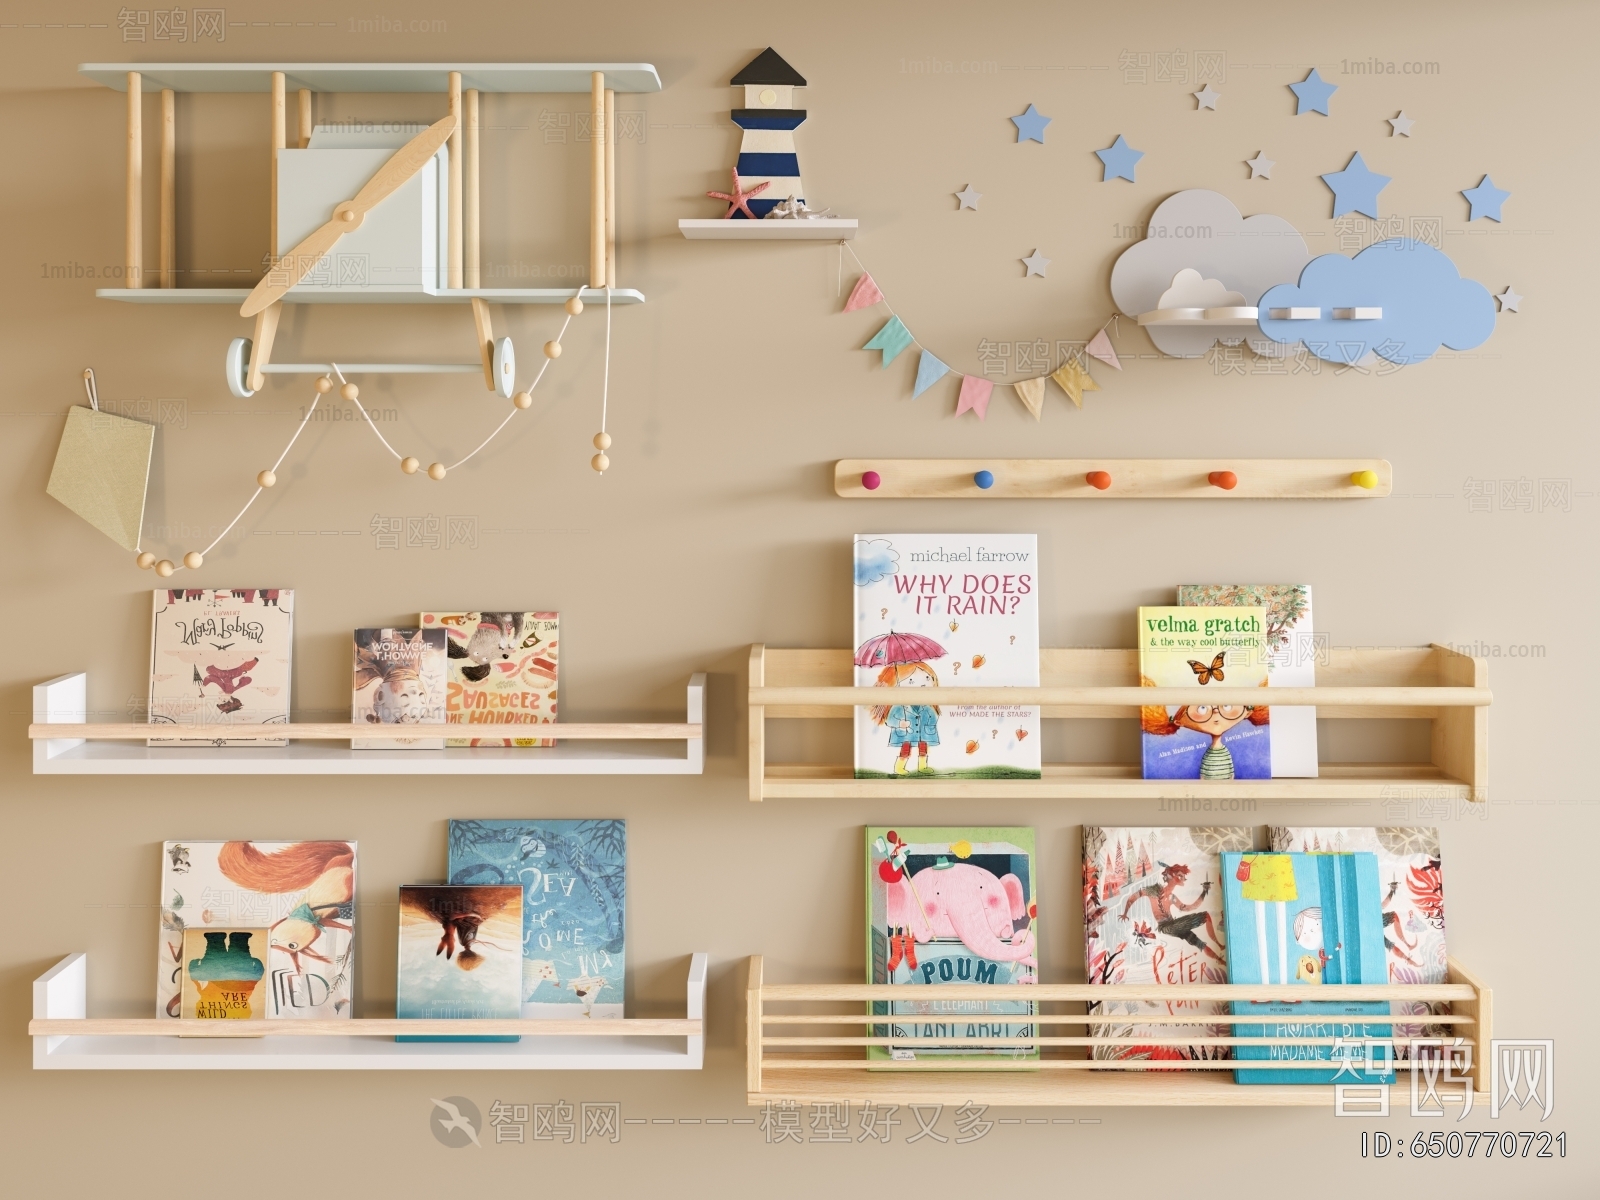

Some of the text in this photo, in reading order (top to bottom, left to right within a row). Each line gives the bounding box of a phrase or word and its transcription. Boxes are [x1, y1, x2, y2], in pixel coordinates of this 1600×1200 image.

[910, 546, 1030, 563] michael farrow
[894, 574, 1032, 594] WHY DOES
[916, 595, 1021, 615] IT RAIN?
[1146, 615, 1261, 636] velma gratch
[1150, 637, 1261, 648] & the way cool butterfly
[920, 957, 998, 985] POUM
